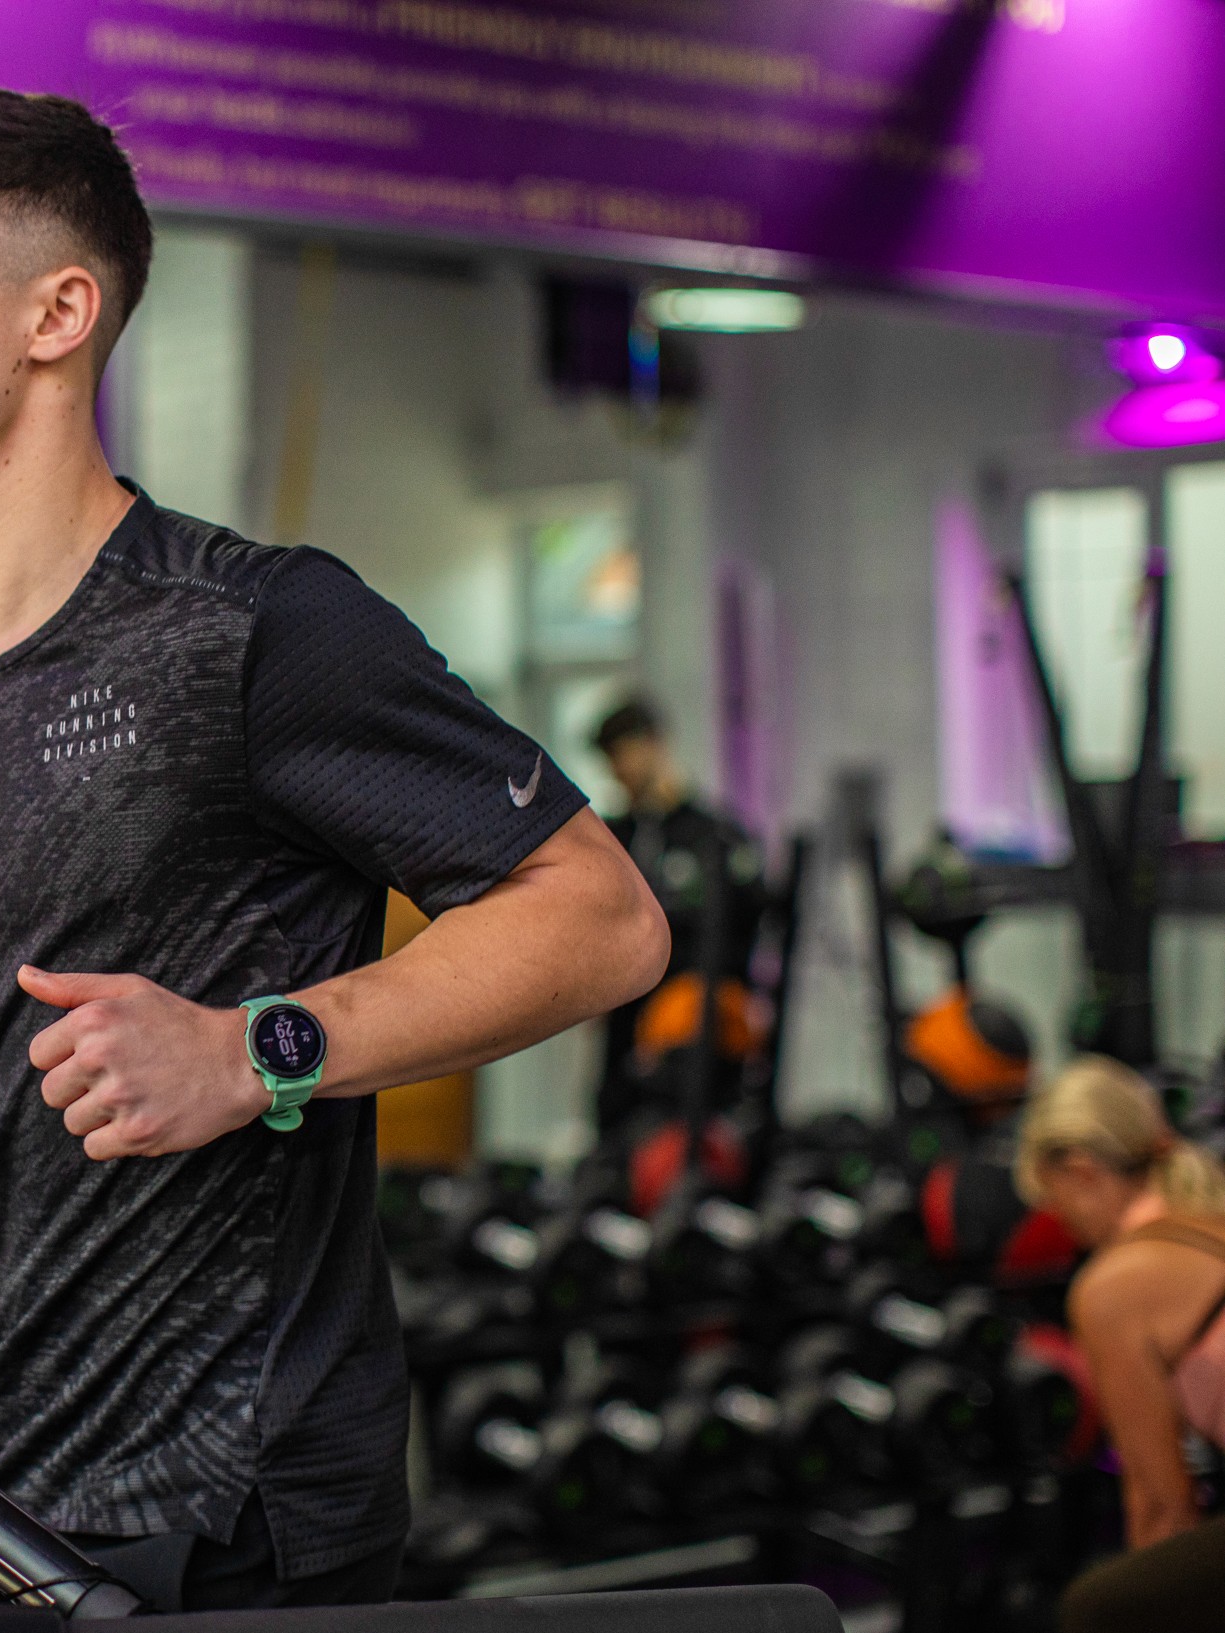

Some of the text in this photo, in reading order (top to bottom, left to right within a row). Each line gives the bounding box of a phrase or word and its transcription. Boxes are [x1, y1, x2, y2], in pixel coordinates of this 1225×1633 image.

[70, 684, 113, 709] NIKE
[46, 703, 135, 739] RUNNING
[43, 729, 136, 763] DIVISION
[275, 1020, 295, 1039] 29
[279, 1037, 298, 1055] 10
